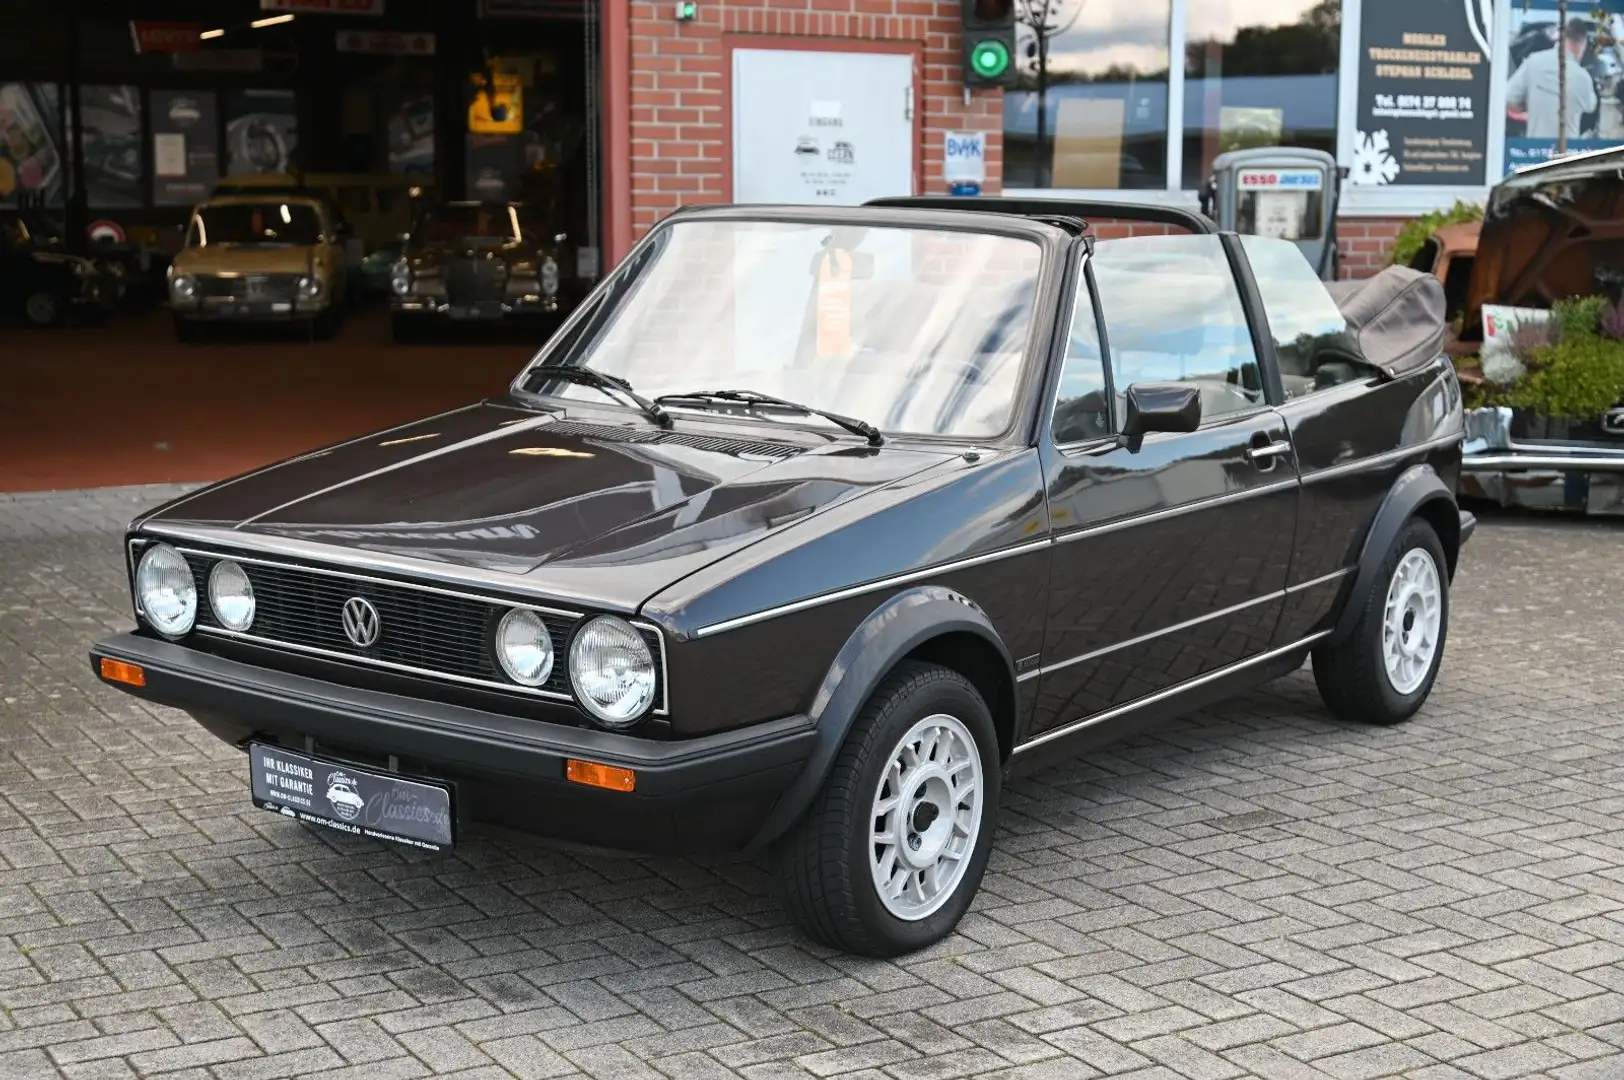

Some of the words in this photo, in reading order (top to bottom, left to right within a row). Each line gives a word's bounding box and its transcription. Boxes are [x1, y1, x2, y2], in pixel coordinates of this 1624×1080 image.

[1242, 173, 1278, 185] ESSO
[342, 597, 378, 647] VW
[263, 756, 276, 770] IHR
[276, 760, 313, 780] KLASSIKER
[266, 772, 278, 787] MIT
[279, 776, 314, 796] GARANTIE
[299, 812, 361, 835] www.om-classics.de
